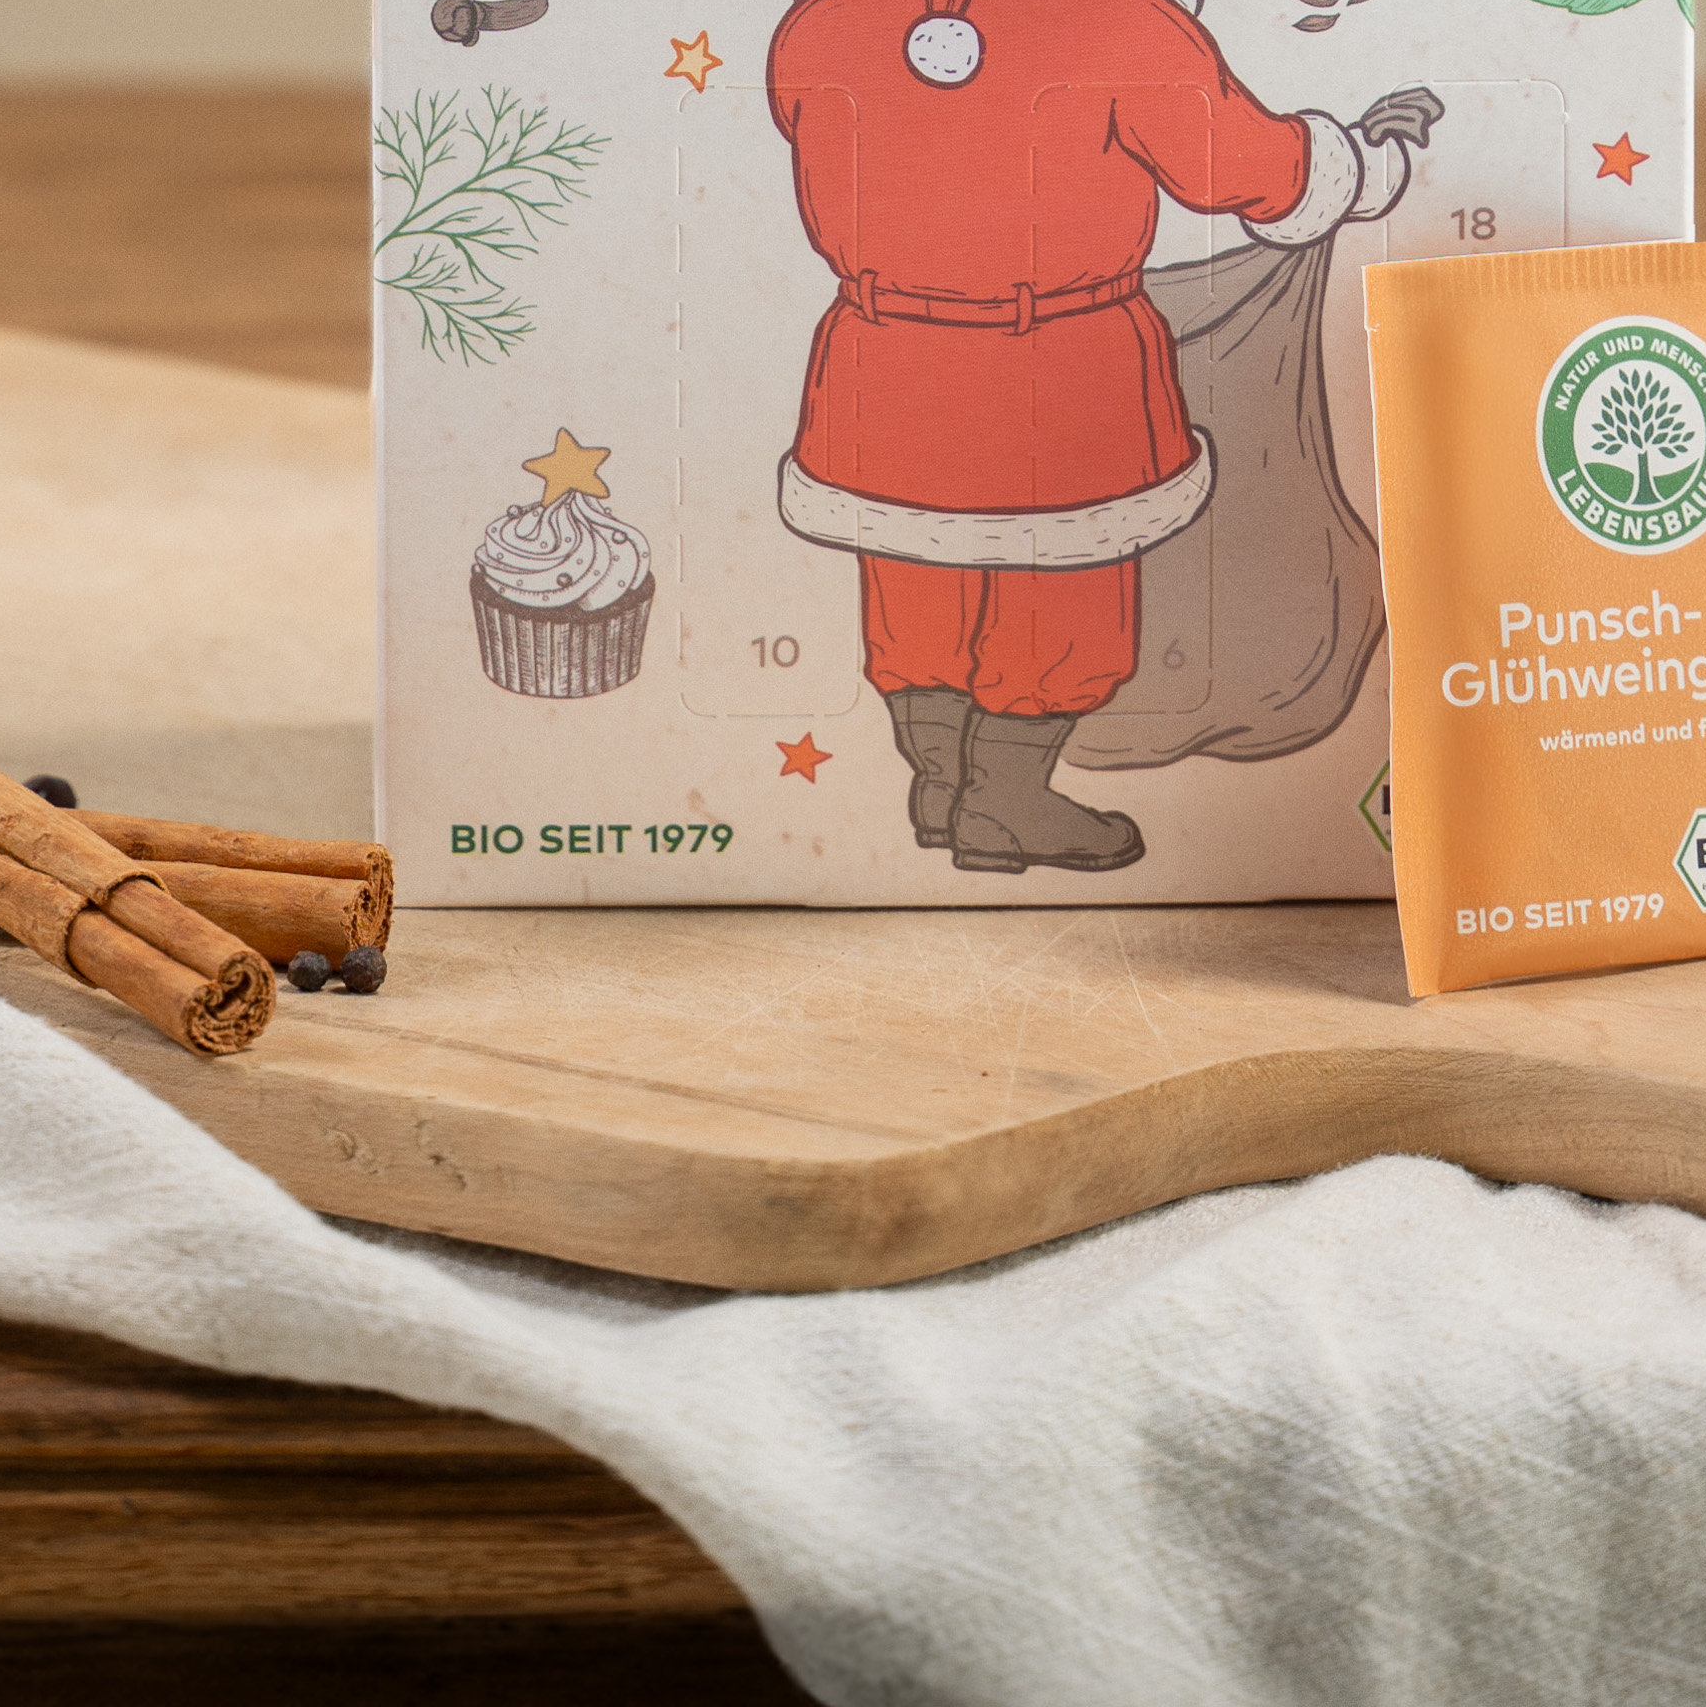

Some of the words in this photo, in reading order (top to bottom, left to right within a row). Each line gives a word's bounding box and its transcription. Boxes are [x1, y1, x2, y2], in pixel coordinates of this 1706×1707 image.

[1451, 207, 1497, 241] 18
[1554, 350, 1600, 411] NATUR
[1603, 335, 1645, 356] UND
[1499, 589, 1702, 648] Punsch-
[751, 635, 800, 668] 10
[1163, 637, 1186, 670] 6
[1539, 723, 1646, 751] wärmend
[1652, 719, 1693, 743] und
[451, 824, 524, 855] BIO
[539, 824, 632, 854] SEIT
[644, 823, 734, 853] 1979
[1456, 906, 1514, 935] BIO
[1525, 899, 1593, 929] SEIT
[1600, 892, 1665, 923] 1979
